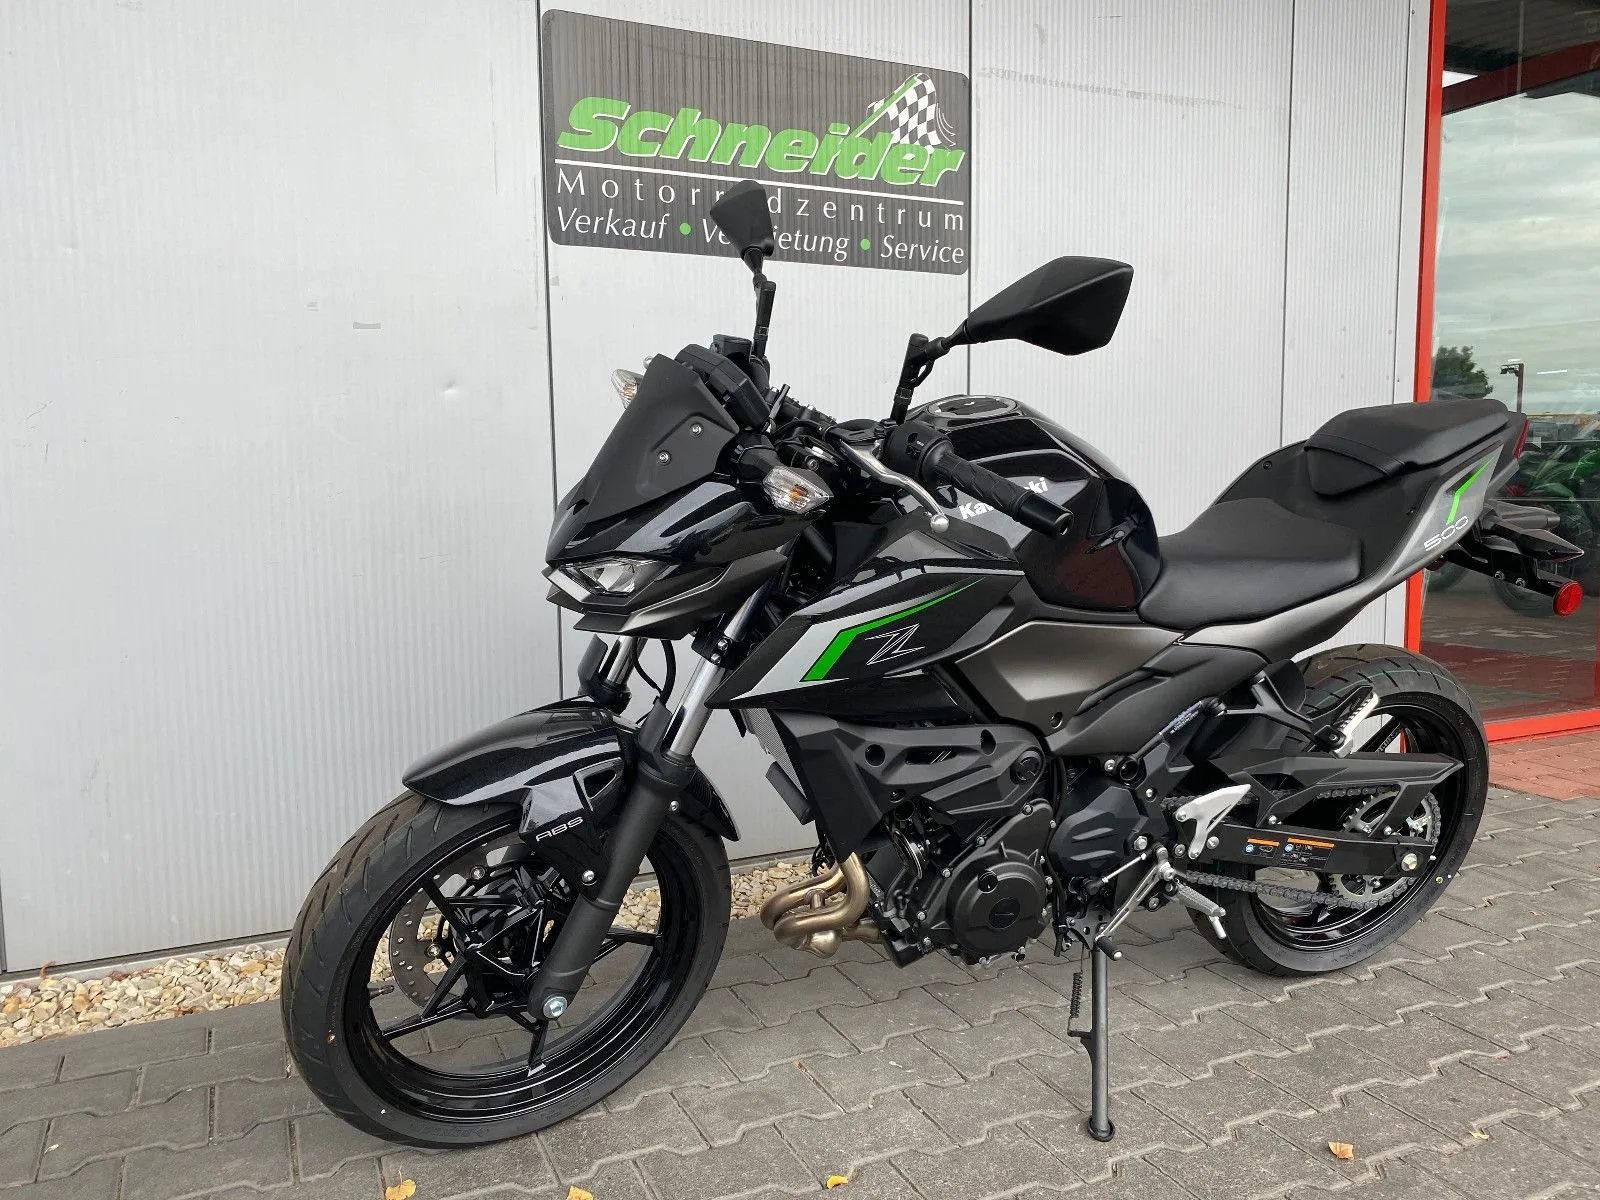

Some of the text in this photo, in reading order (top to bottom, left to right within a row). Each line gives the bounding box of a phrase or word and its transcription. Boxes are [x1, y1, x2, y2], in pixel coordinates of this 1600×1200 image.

[557, 97, 965, 187] Schneider
[557, 168, 964, 231] Motorrdzentrum
[557, 206, 965, 264] Verkauf Veietung Service
[959, 477, 1048, 520] Kaki
[1423, 516, 1469, 551] 500
[865, 623, 925, 665] Z
[535, 816, 583, 842] ABS
